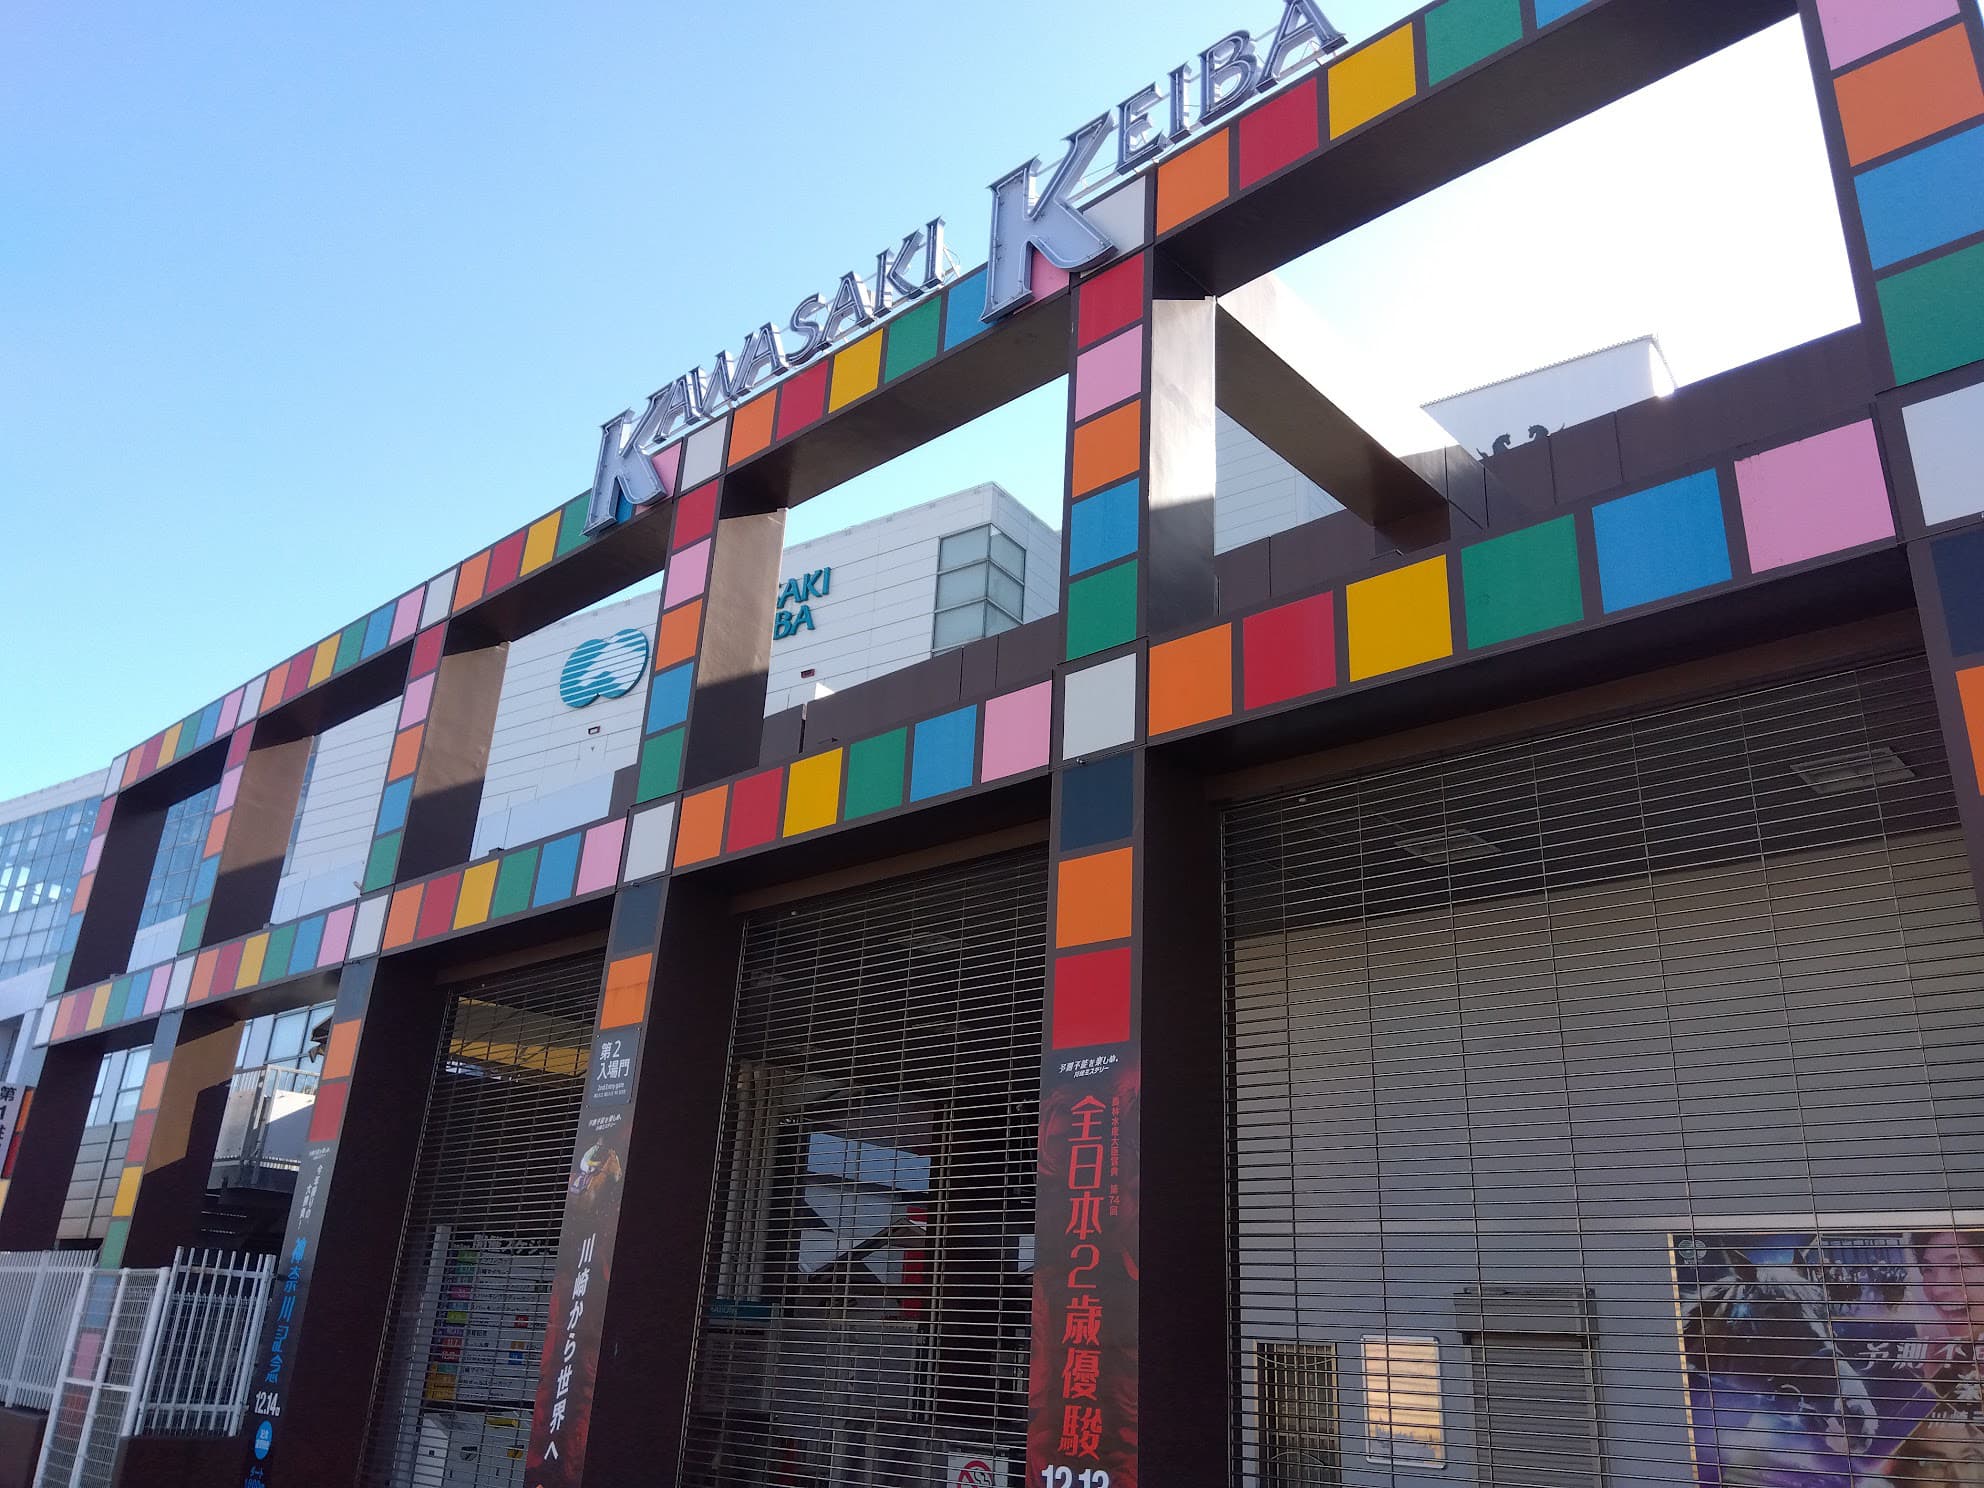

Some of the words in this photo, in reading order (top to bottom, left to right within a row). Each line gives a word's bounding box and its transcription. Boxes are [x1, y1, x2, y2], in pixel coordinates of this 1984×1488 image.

[582, 215, 953, 537] KAWASAKI
[980, 0, 1347, 324] KEIBA
[777, 566, 832, 609] AKI
[596, 1058, 631, 1081] 入場門
[599, 1040, 621, 1061] 第2
[264, 1236, 308, 1385] 神奈川記念
[543, 1232, 596, 1461] 川崎から世界へ
[1058, 1095, 1106, 1461] 全日本2歳優駿
